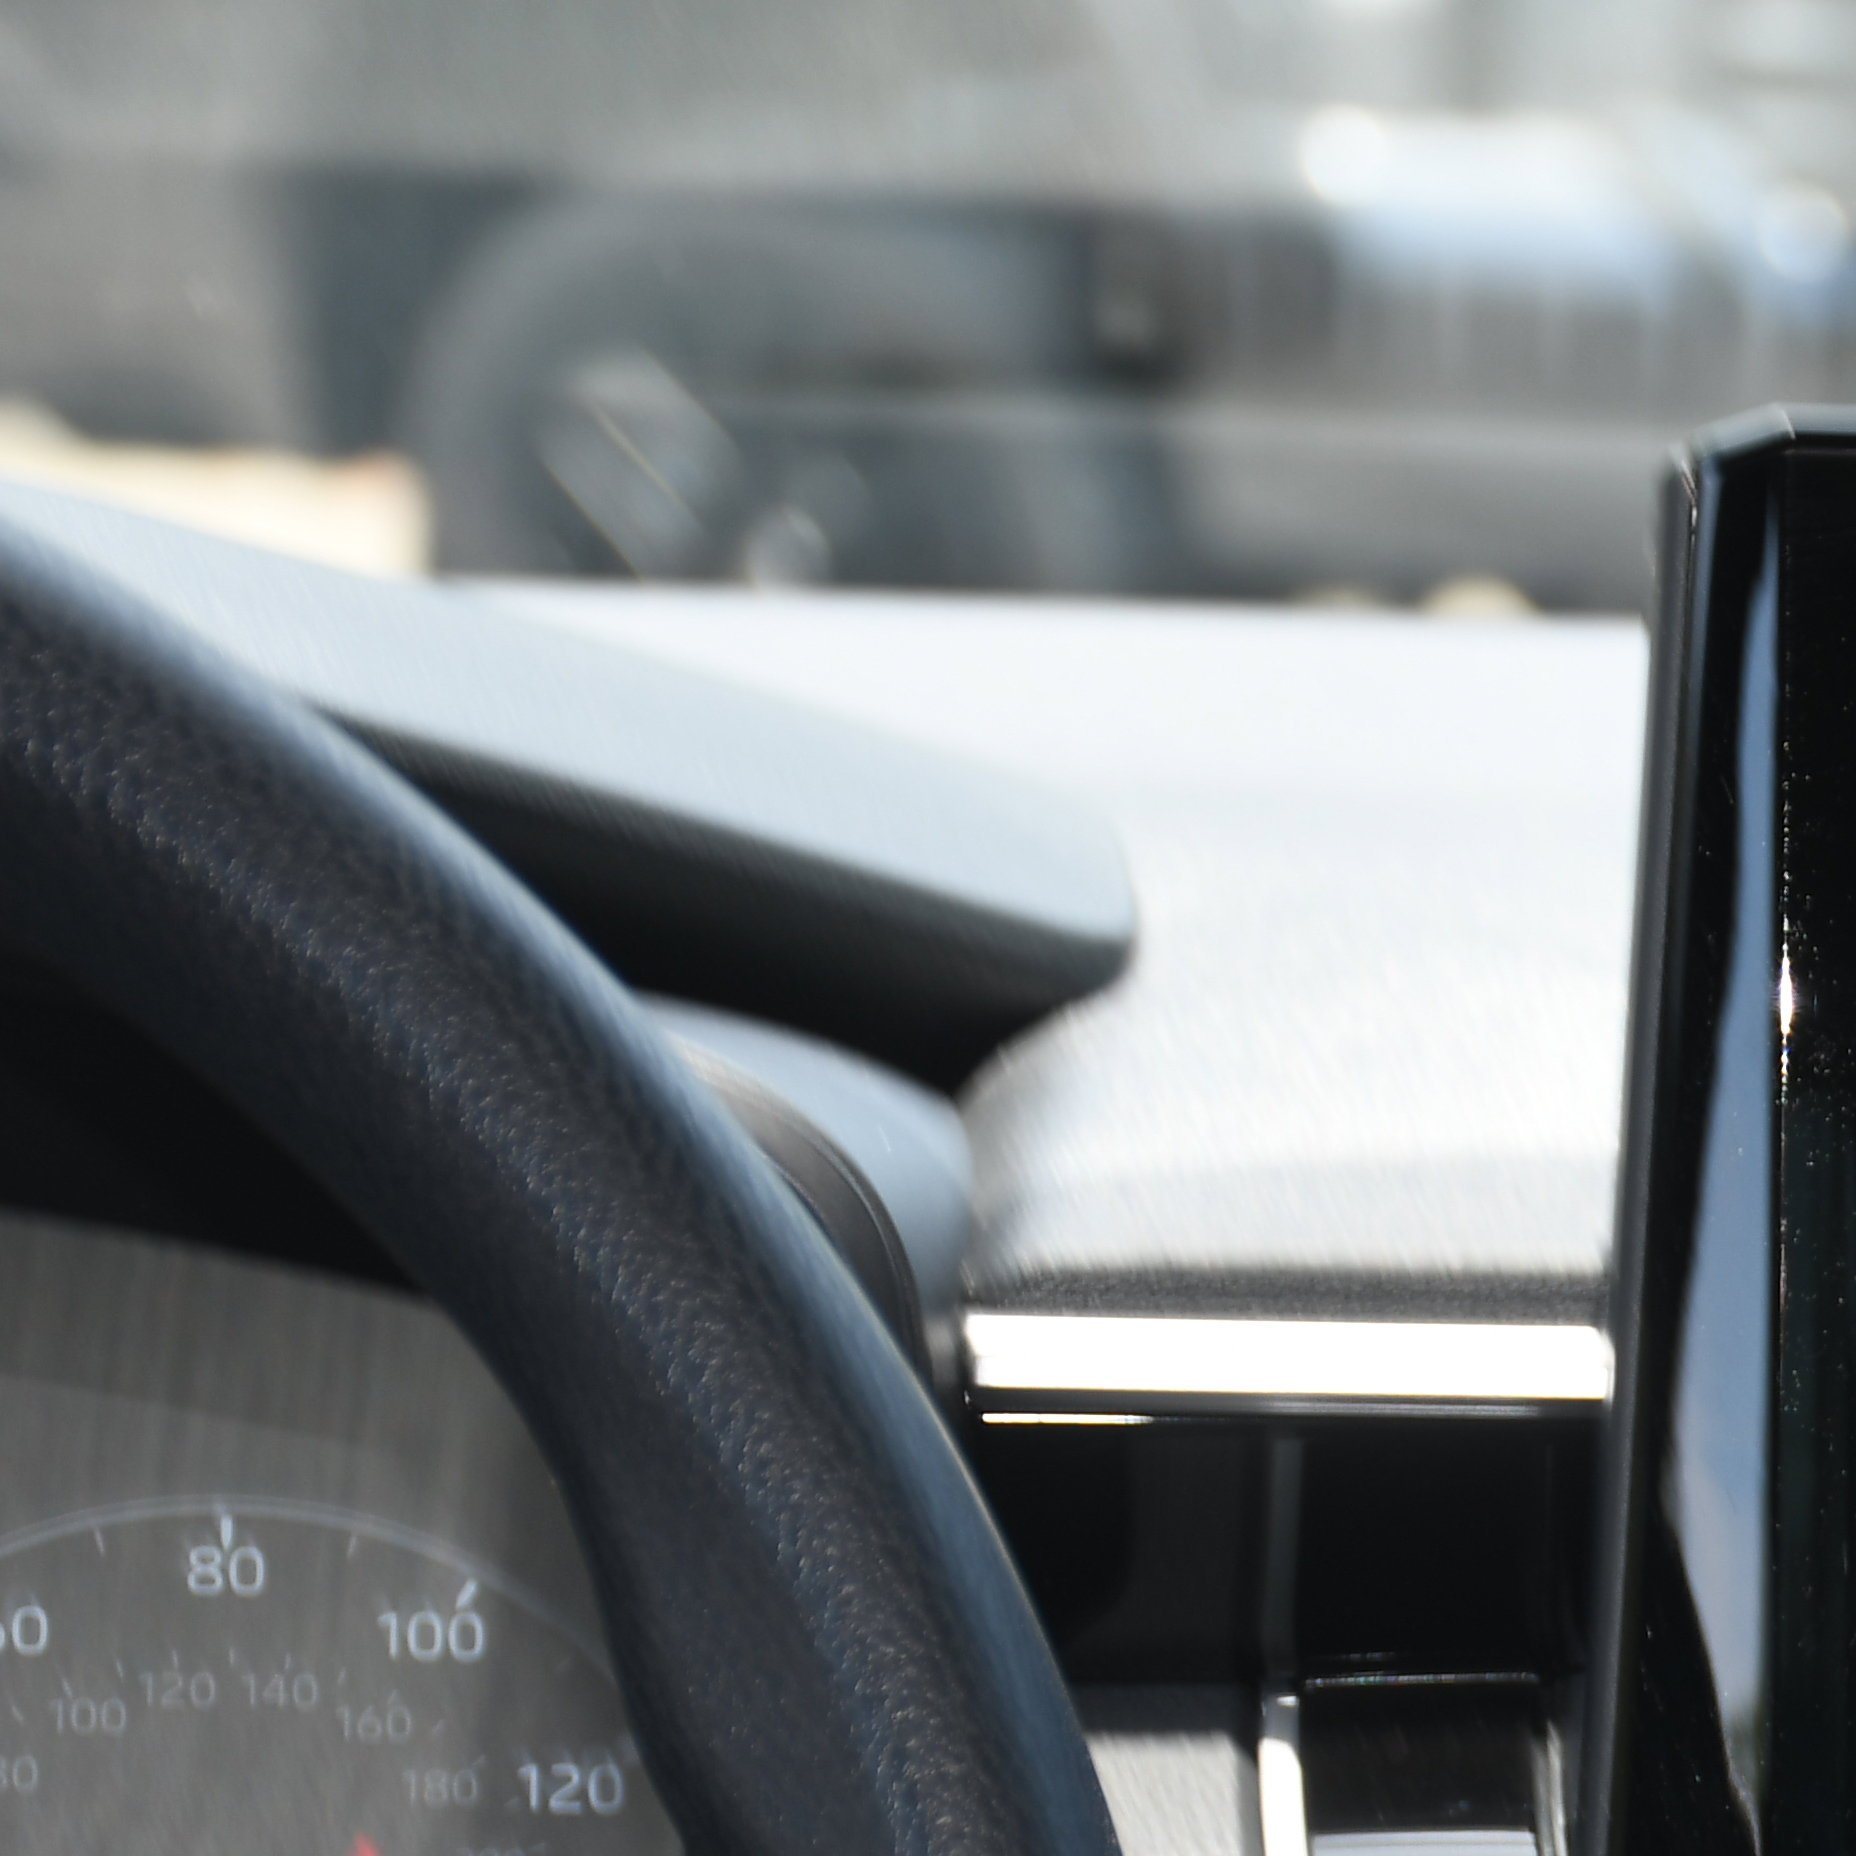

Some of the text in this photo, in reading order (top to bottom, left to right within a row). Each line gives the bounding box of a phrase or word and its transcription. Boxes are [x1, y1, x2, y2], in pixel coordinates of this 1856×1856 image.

[187, 1545, 265, 1597] 80
[0, 1605, 48, 1656] 0
[377, 1611, 485, 1661] 100
[140, 1671, 216, 1710] 120
[241, 1672, 318, 1710] 140
[52, 1698, 128, 1735] 100
[337, 1704, 412, 1743] 160
[406, 1767, 480, 1804] 180
[517, 1763, 624, 1813] 120
